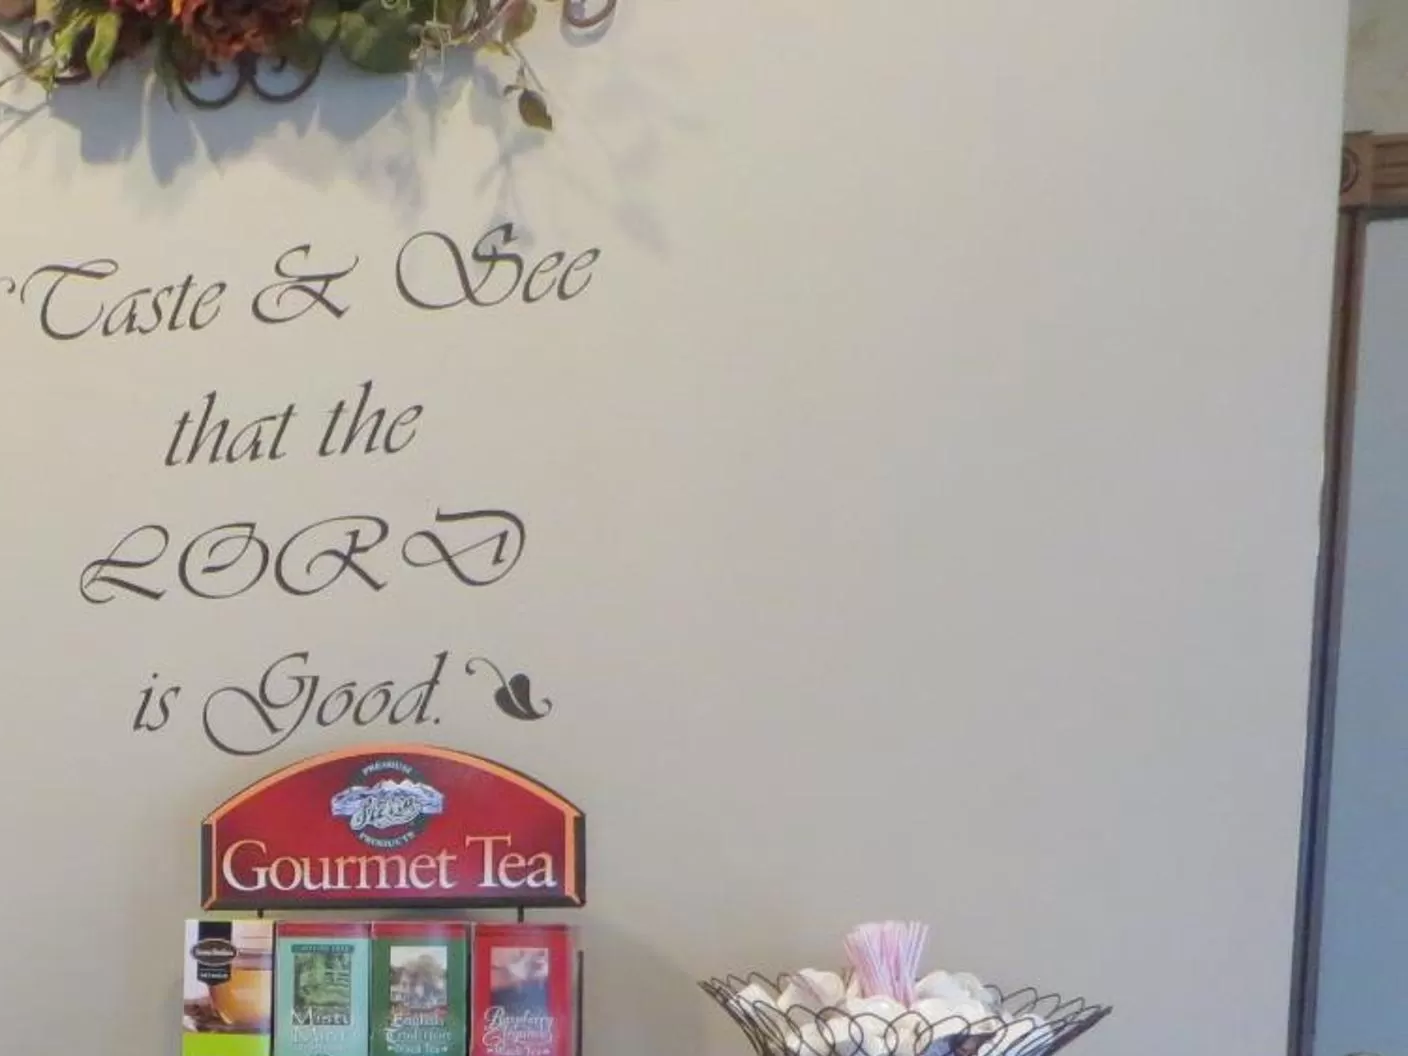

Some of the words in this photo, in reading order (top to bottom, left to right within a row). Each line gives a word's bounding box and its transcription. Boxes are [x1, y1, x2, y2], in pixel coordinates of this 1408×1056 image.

[19, 257, 228, 342] Taste
[251, 244, 360, 324] &
[394, 222, 602, 312] See
[164, 391, 296, 467] that
[317, 380, 424, 458] the
[79, 507, 527, 605] LORD
[132, 672, 180, 732] is
[221, 839, 458, 893] Gourmet
[464, 833, 559, 891] Tea
